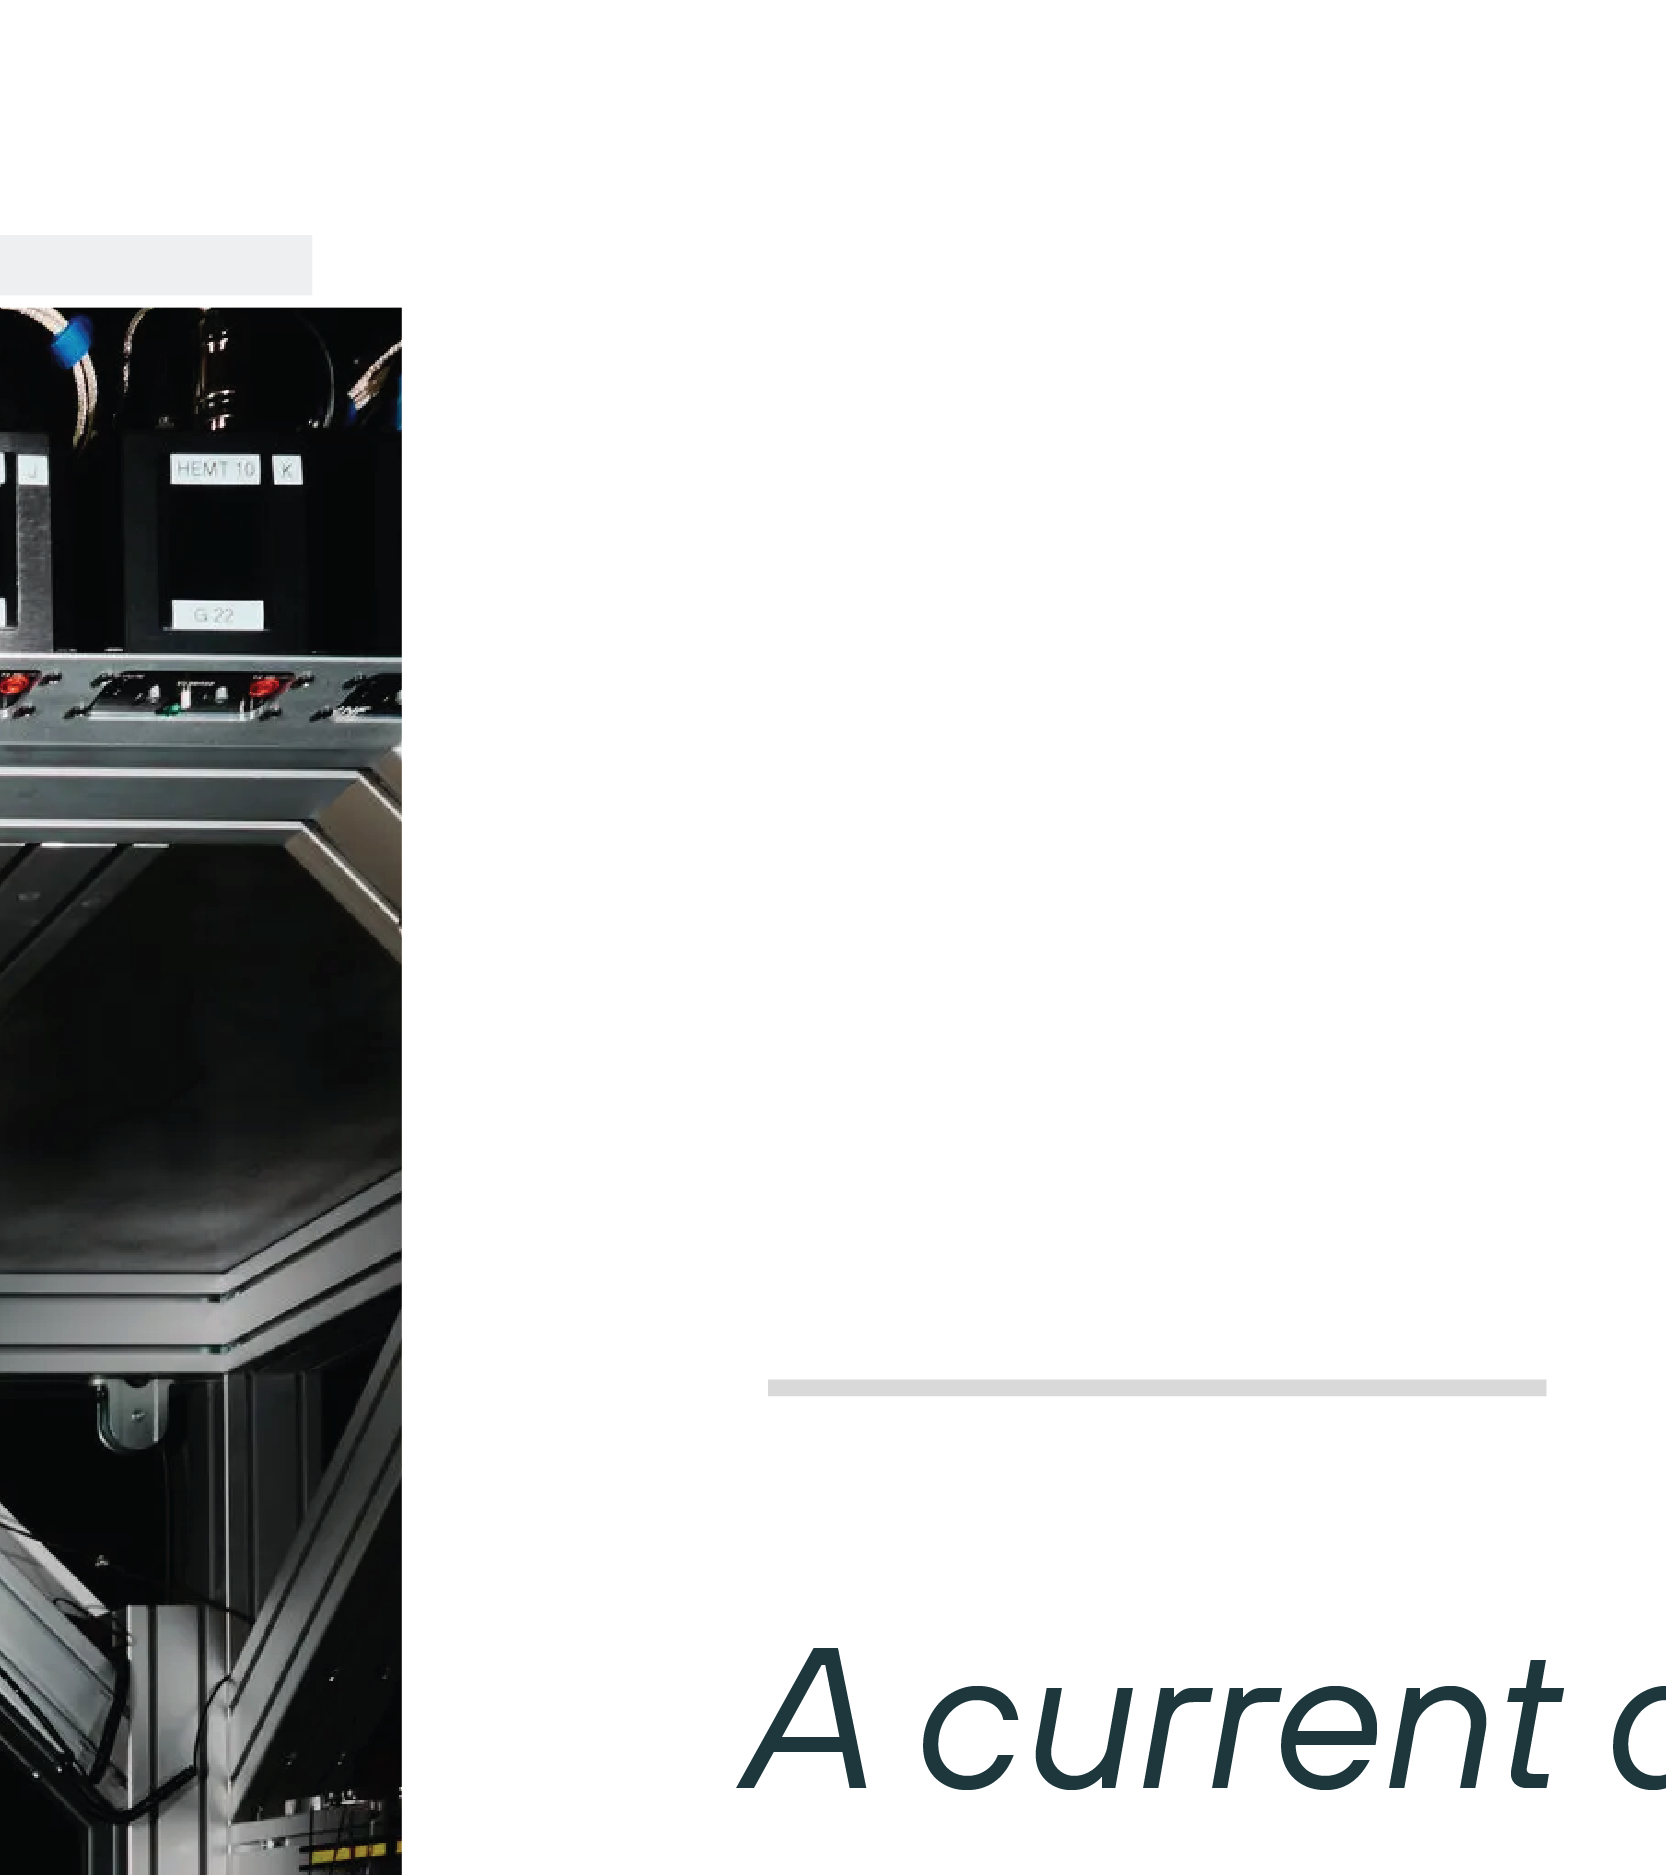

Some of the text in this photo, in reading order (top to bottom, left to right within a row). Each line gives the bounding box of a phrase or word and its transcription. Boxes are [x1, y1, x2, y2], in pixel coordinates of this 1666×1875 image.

[177, 460, 256, 477] HEMT 10
[281, 461, 293, 480] K
[193, 606, 235, 623] G 22
